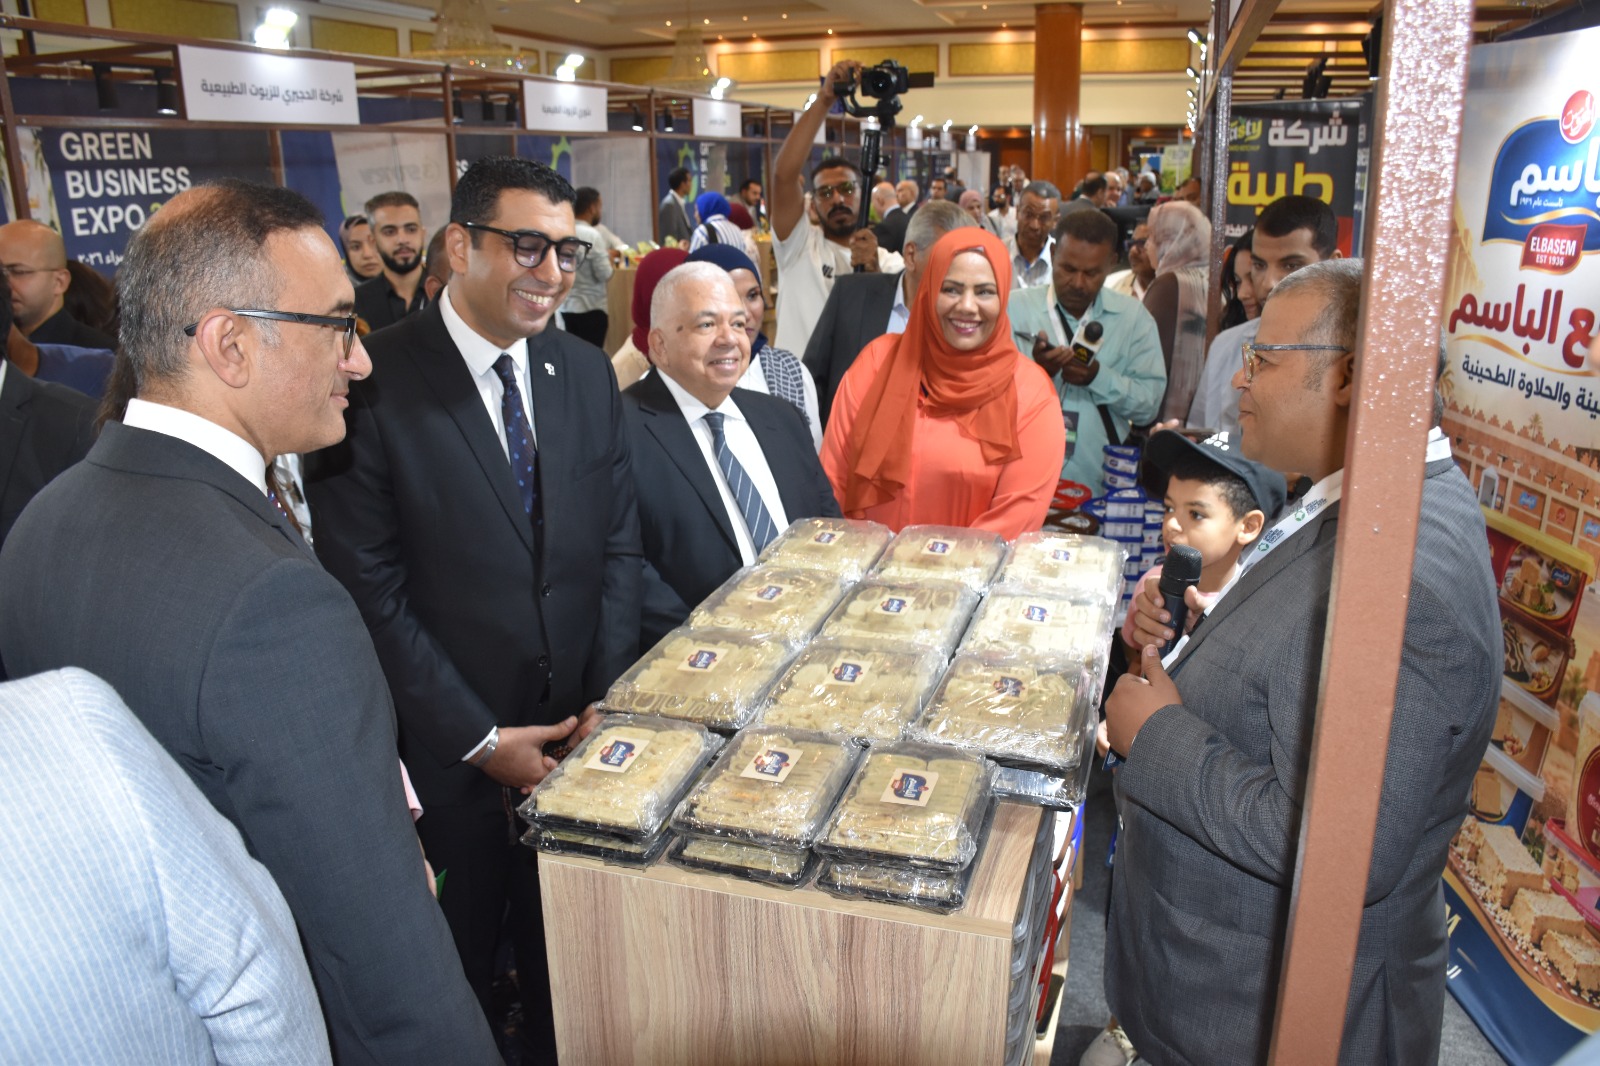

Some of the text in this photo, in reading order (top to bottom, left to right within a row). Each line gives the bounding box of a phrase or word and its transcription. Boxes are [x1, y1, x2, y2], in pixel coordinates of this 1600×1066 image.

[200, 79, 247, 98] الطبيعية
[319, 88, 344, 105] شركة
[60, 132, 152, 161] GREEN
[1268, 110, 1348, 154] شركة
[65, 166, 191, 199] BUSINESS
[71, 203, 146, 237] EXPO
[1530, 236, 1577, 257] ELBASEM
[1535, 254, 1565, 267] EST 1936
[1449, 283, 1564, 356] الباسم
[1462, 354, 1516, 388] الطحينية
[1518, 372, 1571, 411] والحلاوة
